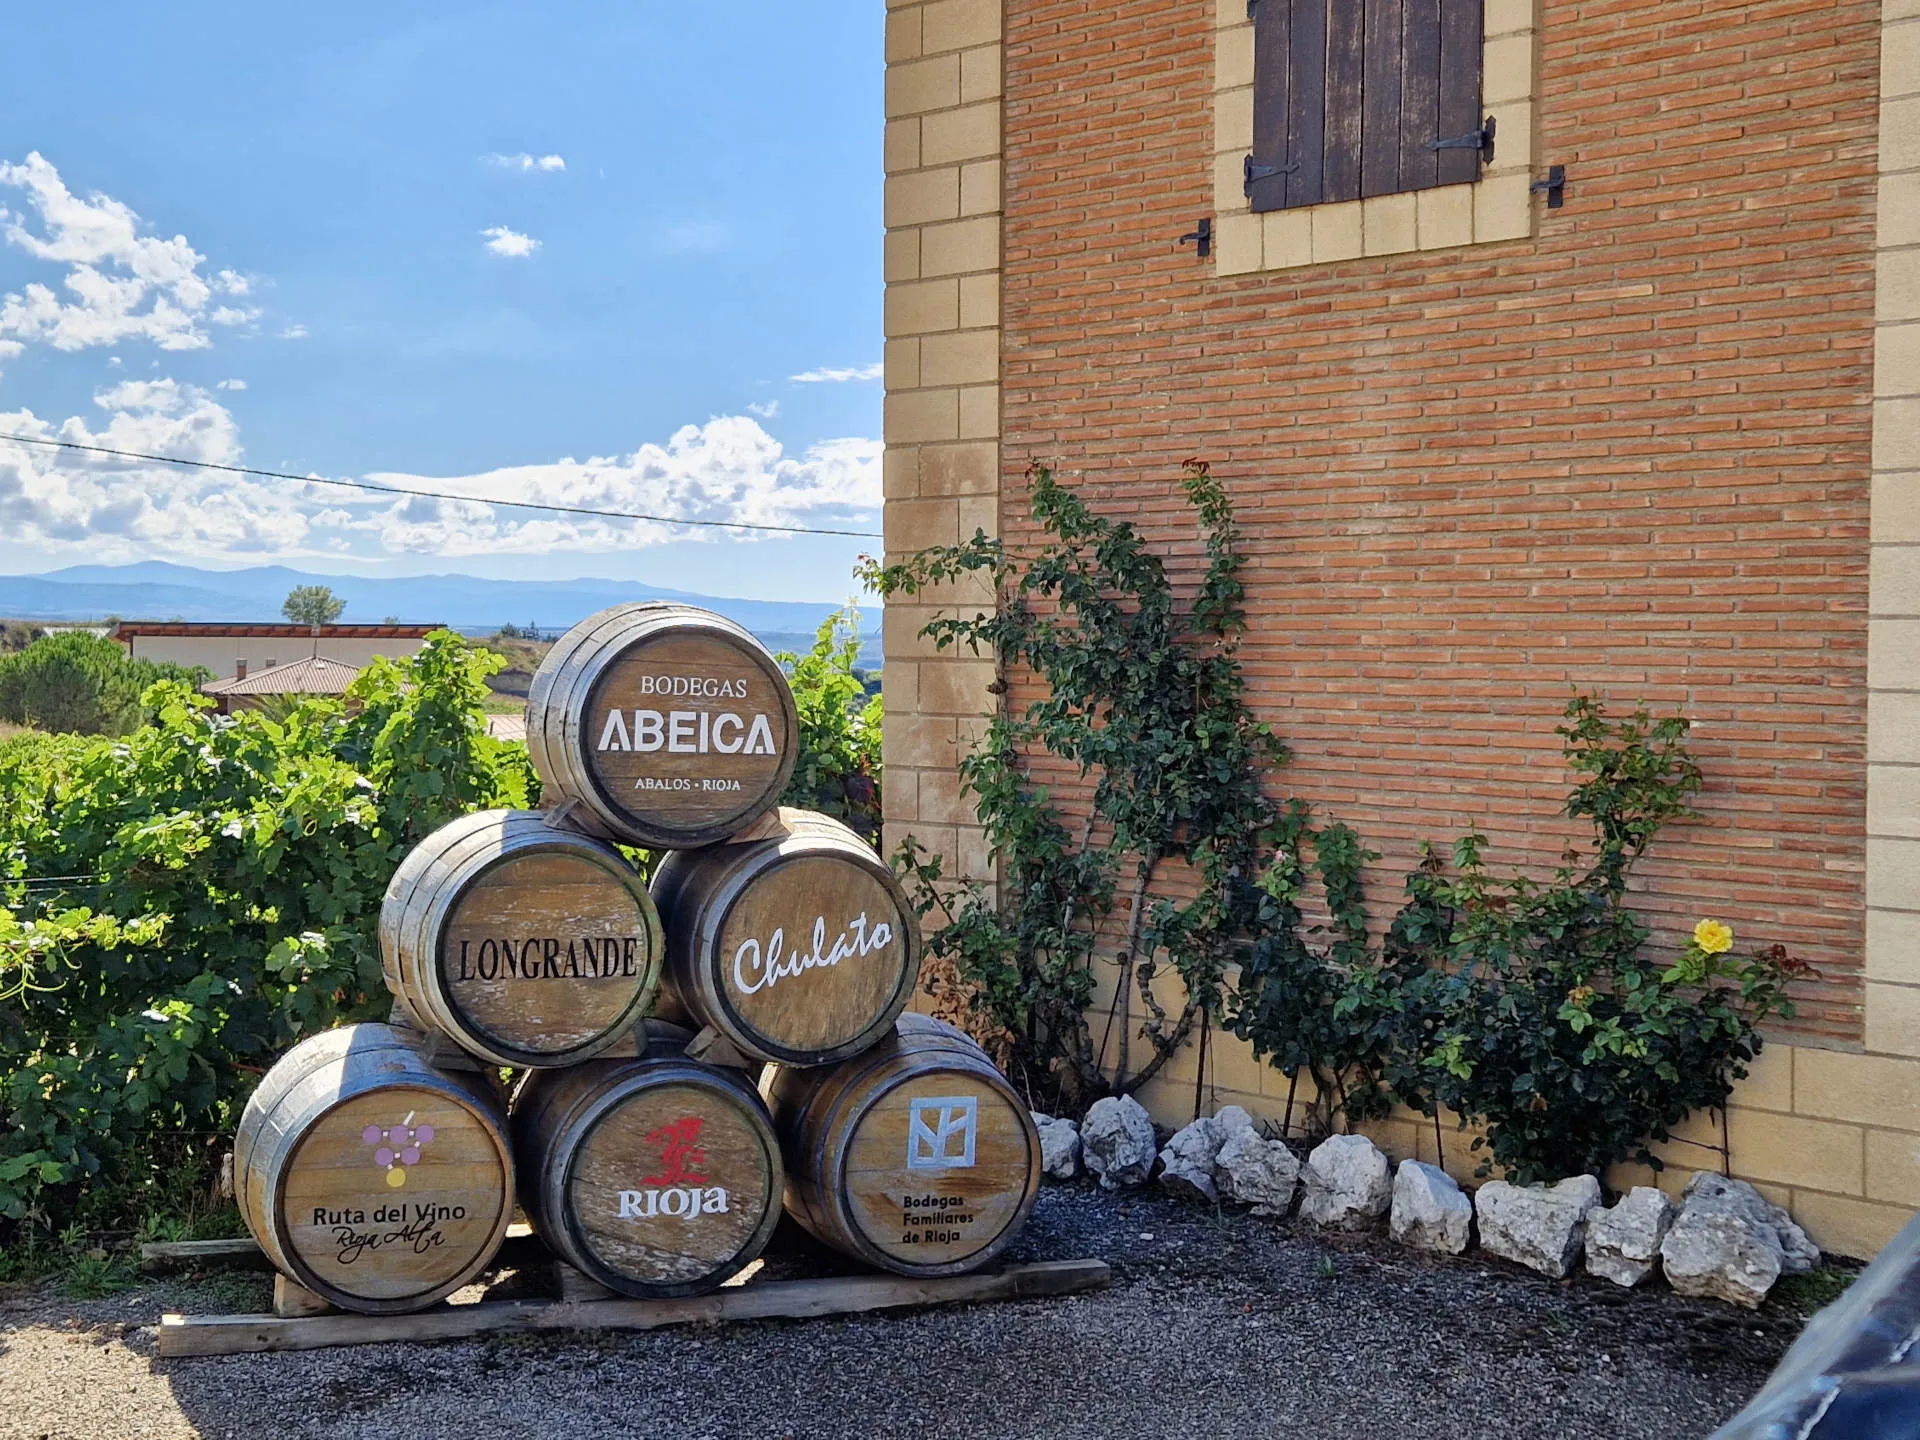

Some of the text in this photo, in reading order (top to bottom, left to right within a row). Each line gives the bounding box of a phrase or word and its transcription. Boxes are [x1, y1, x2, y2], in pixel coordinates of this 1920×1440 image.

[640, 676, 747, 698] BODEGAS
[598, 708, 776, 755] ABEICA
[634, 778, 741, 792] ABALOS RIOJA
[459, 937, 637, 981] LONGRANDE
[733, 911, 892, 994] Chulato
[903, 1195, 964, 1210] Bodegas
[313, 1203, 466, 1225] Ruta del Vino
[903, 1212, 974, 1226] Familiares
[332, 1219, 445, 1265] Rioja Alta
[902, 1230, 960, 1245] de Rioja
